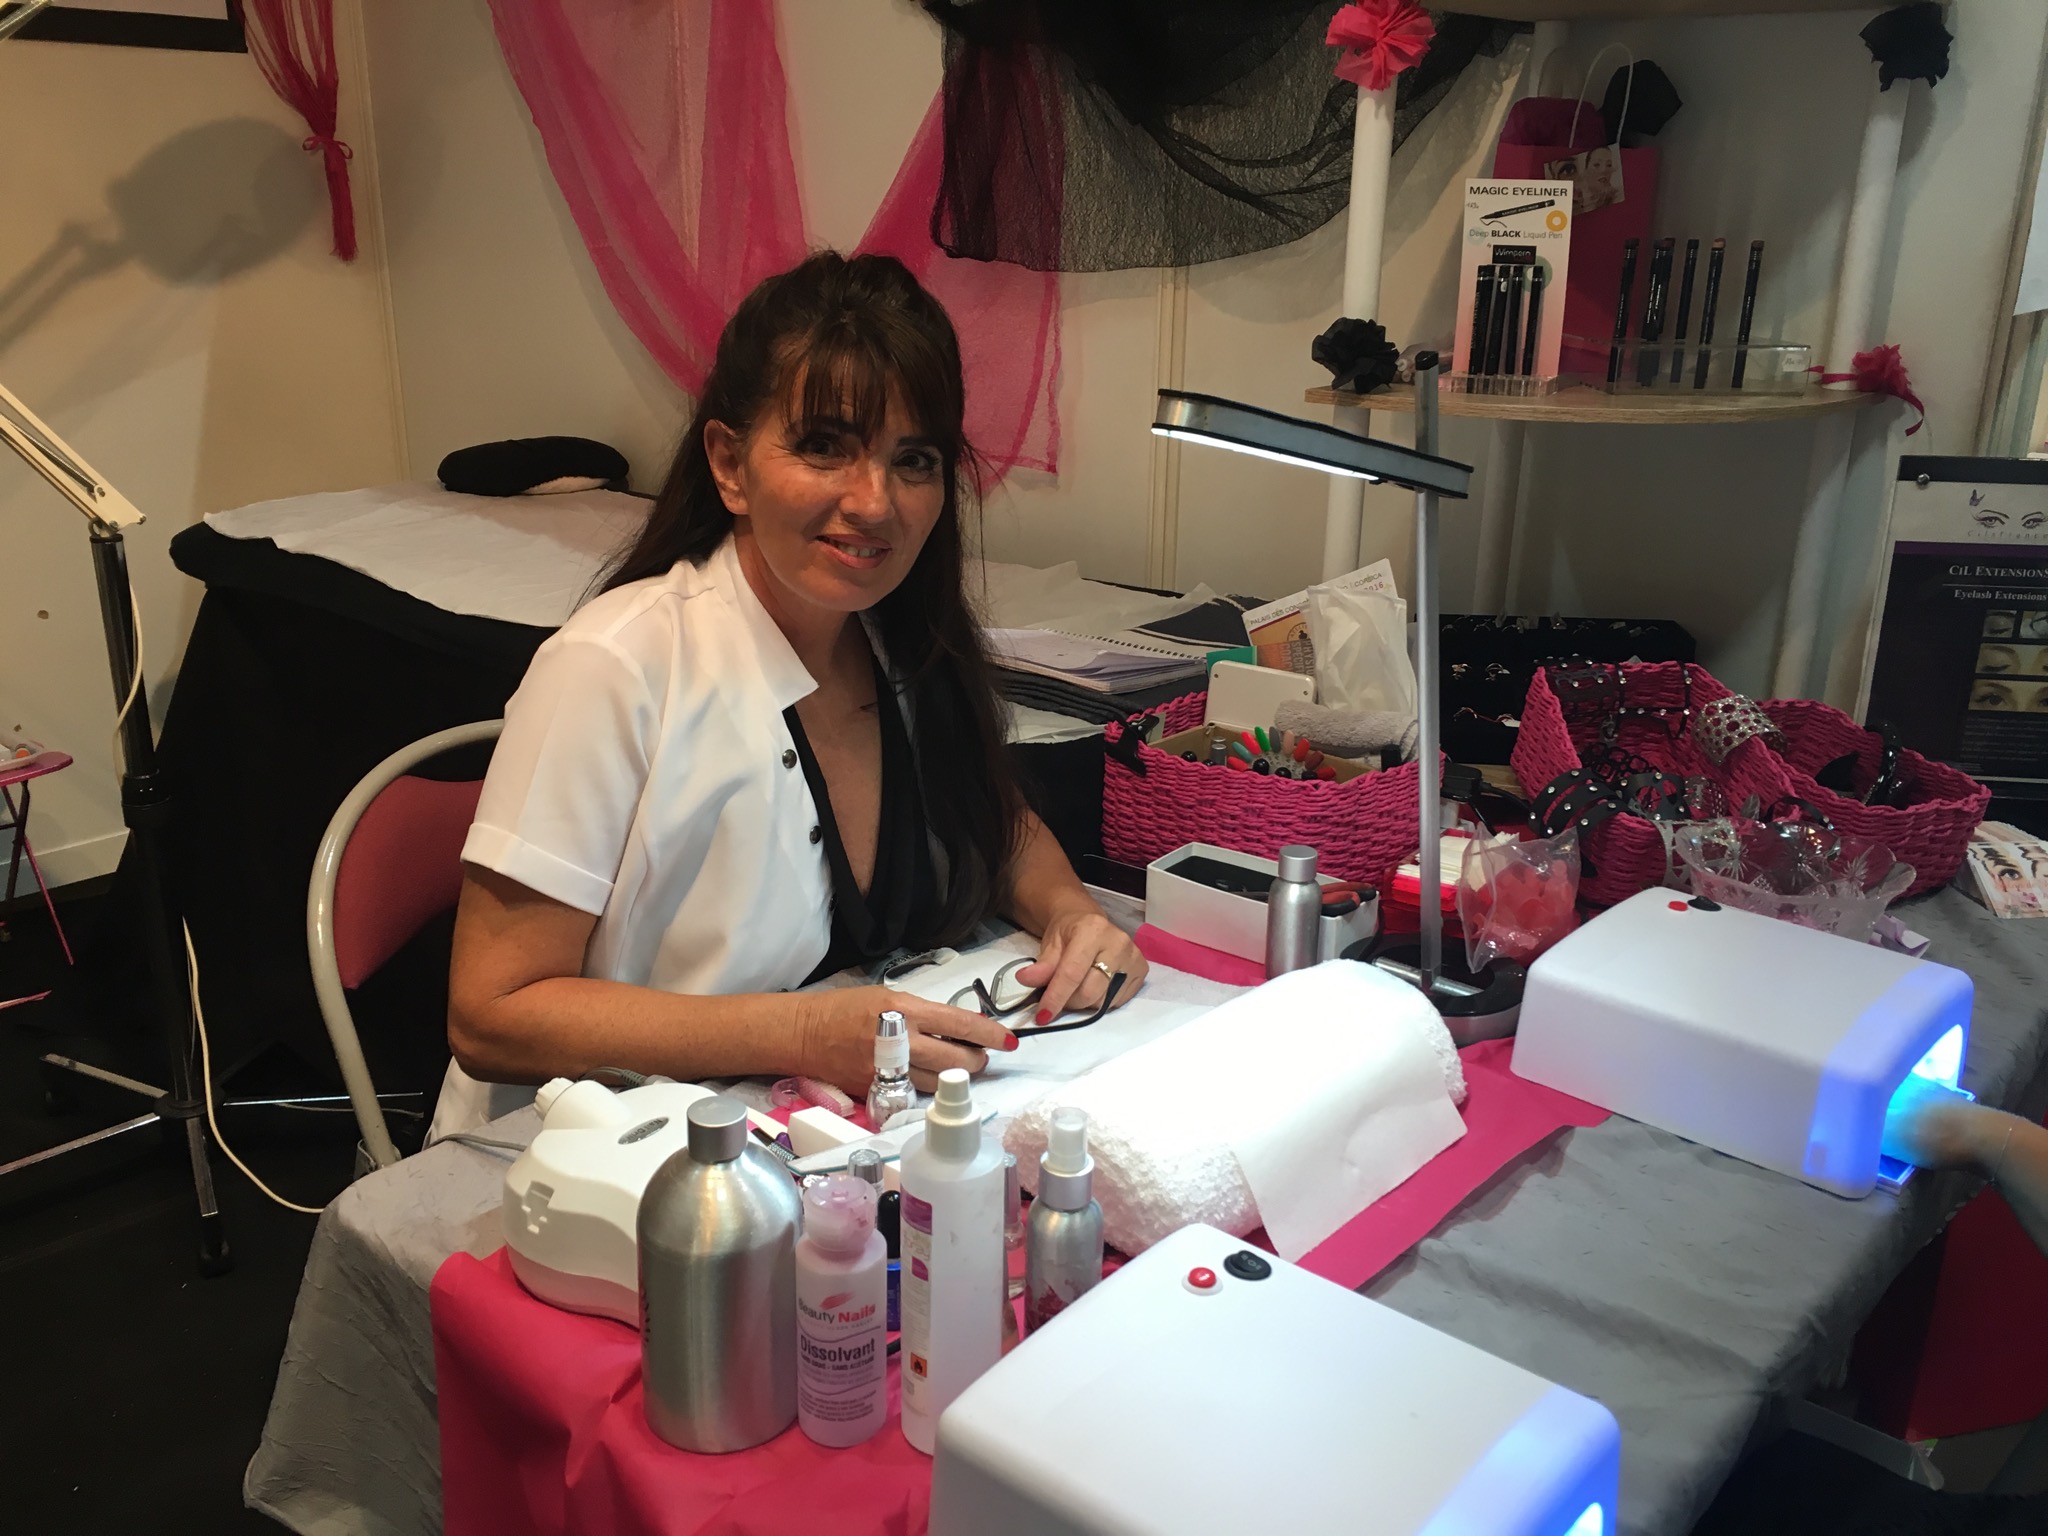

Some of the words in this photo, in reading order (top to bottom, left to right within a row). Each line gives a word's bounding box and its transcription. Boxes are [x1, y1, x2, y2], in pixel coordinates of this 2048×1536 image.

[1469, 186, 1509, 196] MAGIC
[1512, 187, 1568, 197] EYELINER
[1469, 229, 1489, 239] Deep
[1491, 230, 1521, 238] BLACK
[1523, 231, 1547, 239] Liquid
[1975, 565, 2048, 578] EXTENSIONS
[1363, 581, 1384, 591] 016
[1954, 589, 1992, 600] Eyelash
[1994, 590, 2047, 601] Extensions
[1250, 614, 1272, 626] PALAIS
[798, 1297, 836, 1324] Beauty
[837, 1303, 877, 1324] Nails
[800, 1333, 876, 1363] Dissolvant
